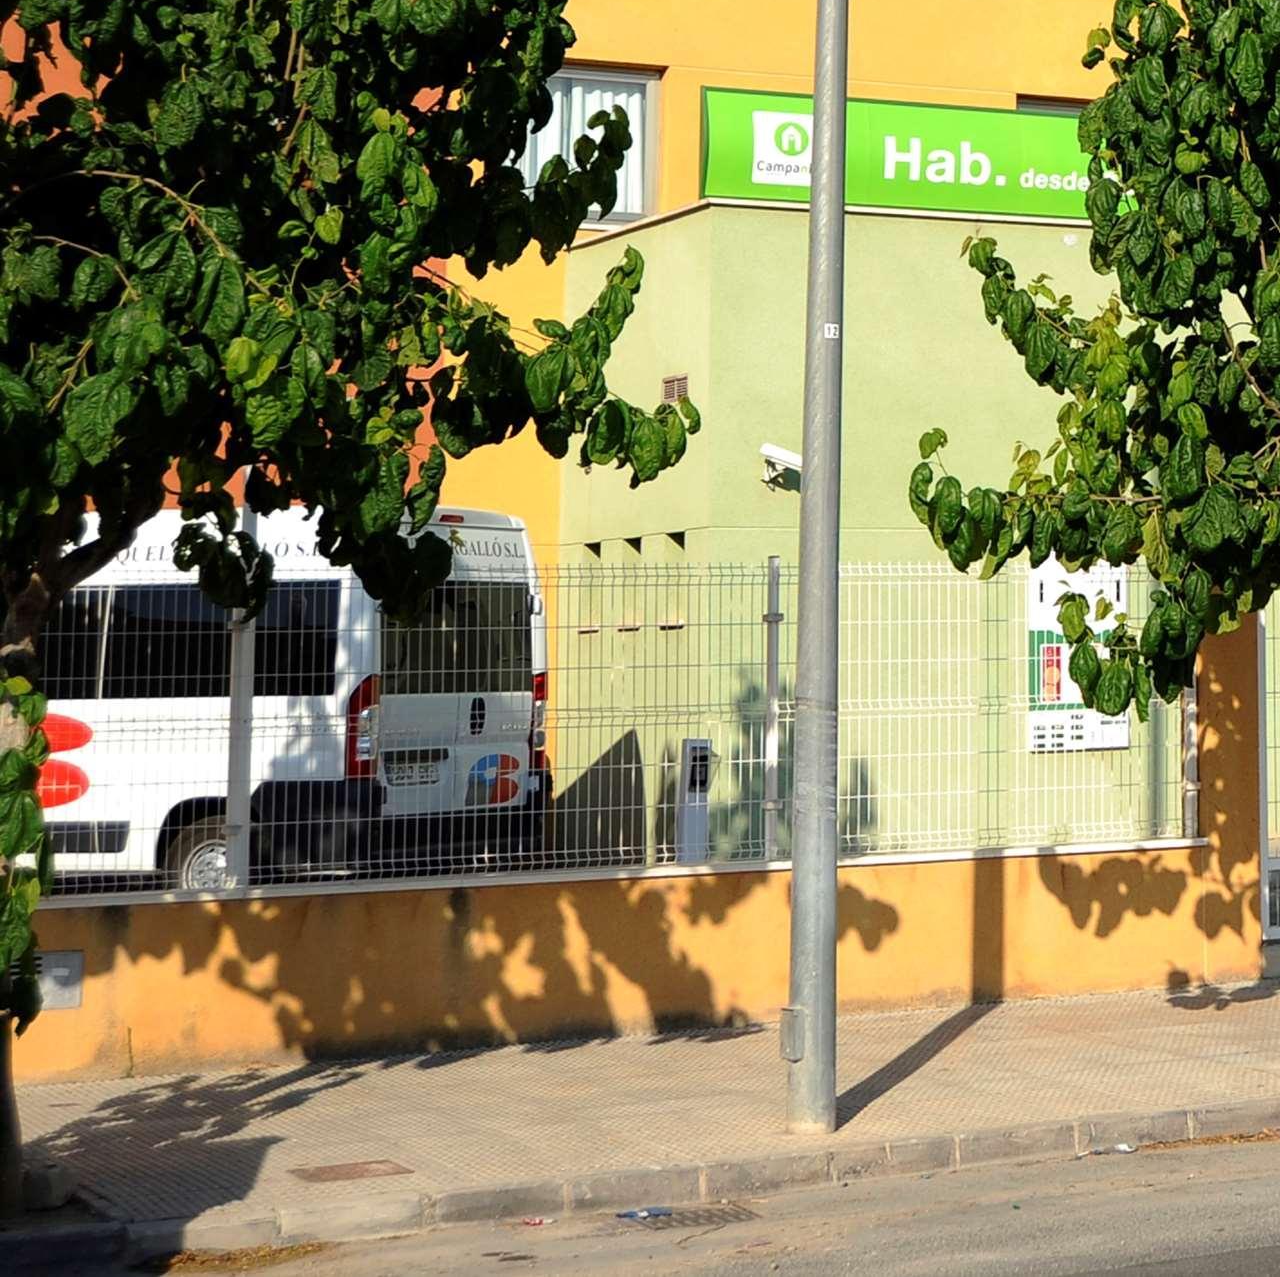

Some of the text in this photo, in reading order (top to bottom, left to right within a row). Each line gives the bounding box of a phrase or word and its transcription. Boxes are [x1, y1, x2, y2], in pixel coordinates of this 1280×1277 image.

[757, 160, 811, 176] Campan
[883, 135, 1007, 186] Hab.
[1019, 167, 1090, 192] desde
